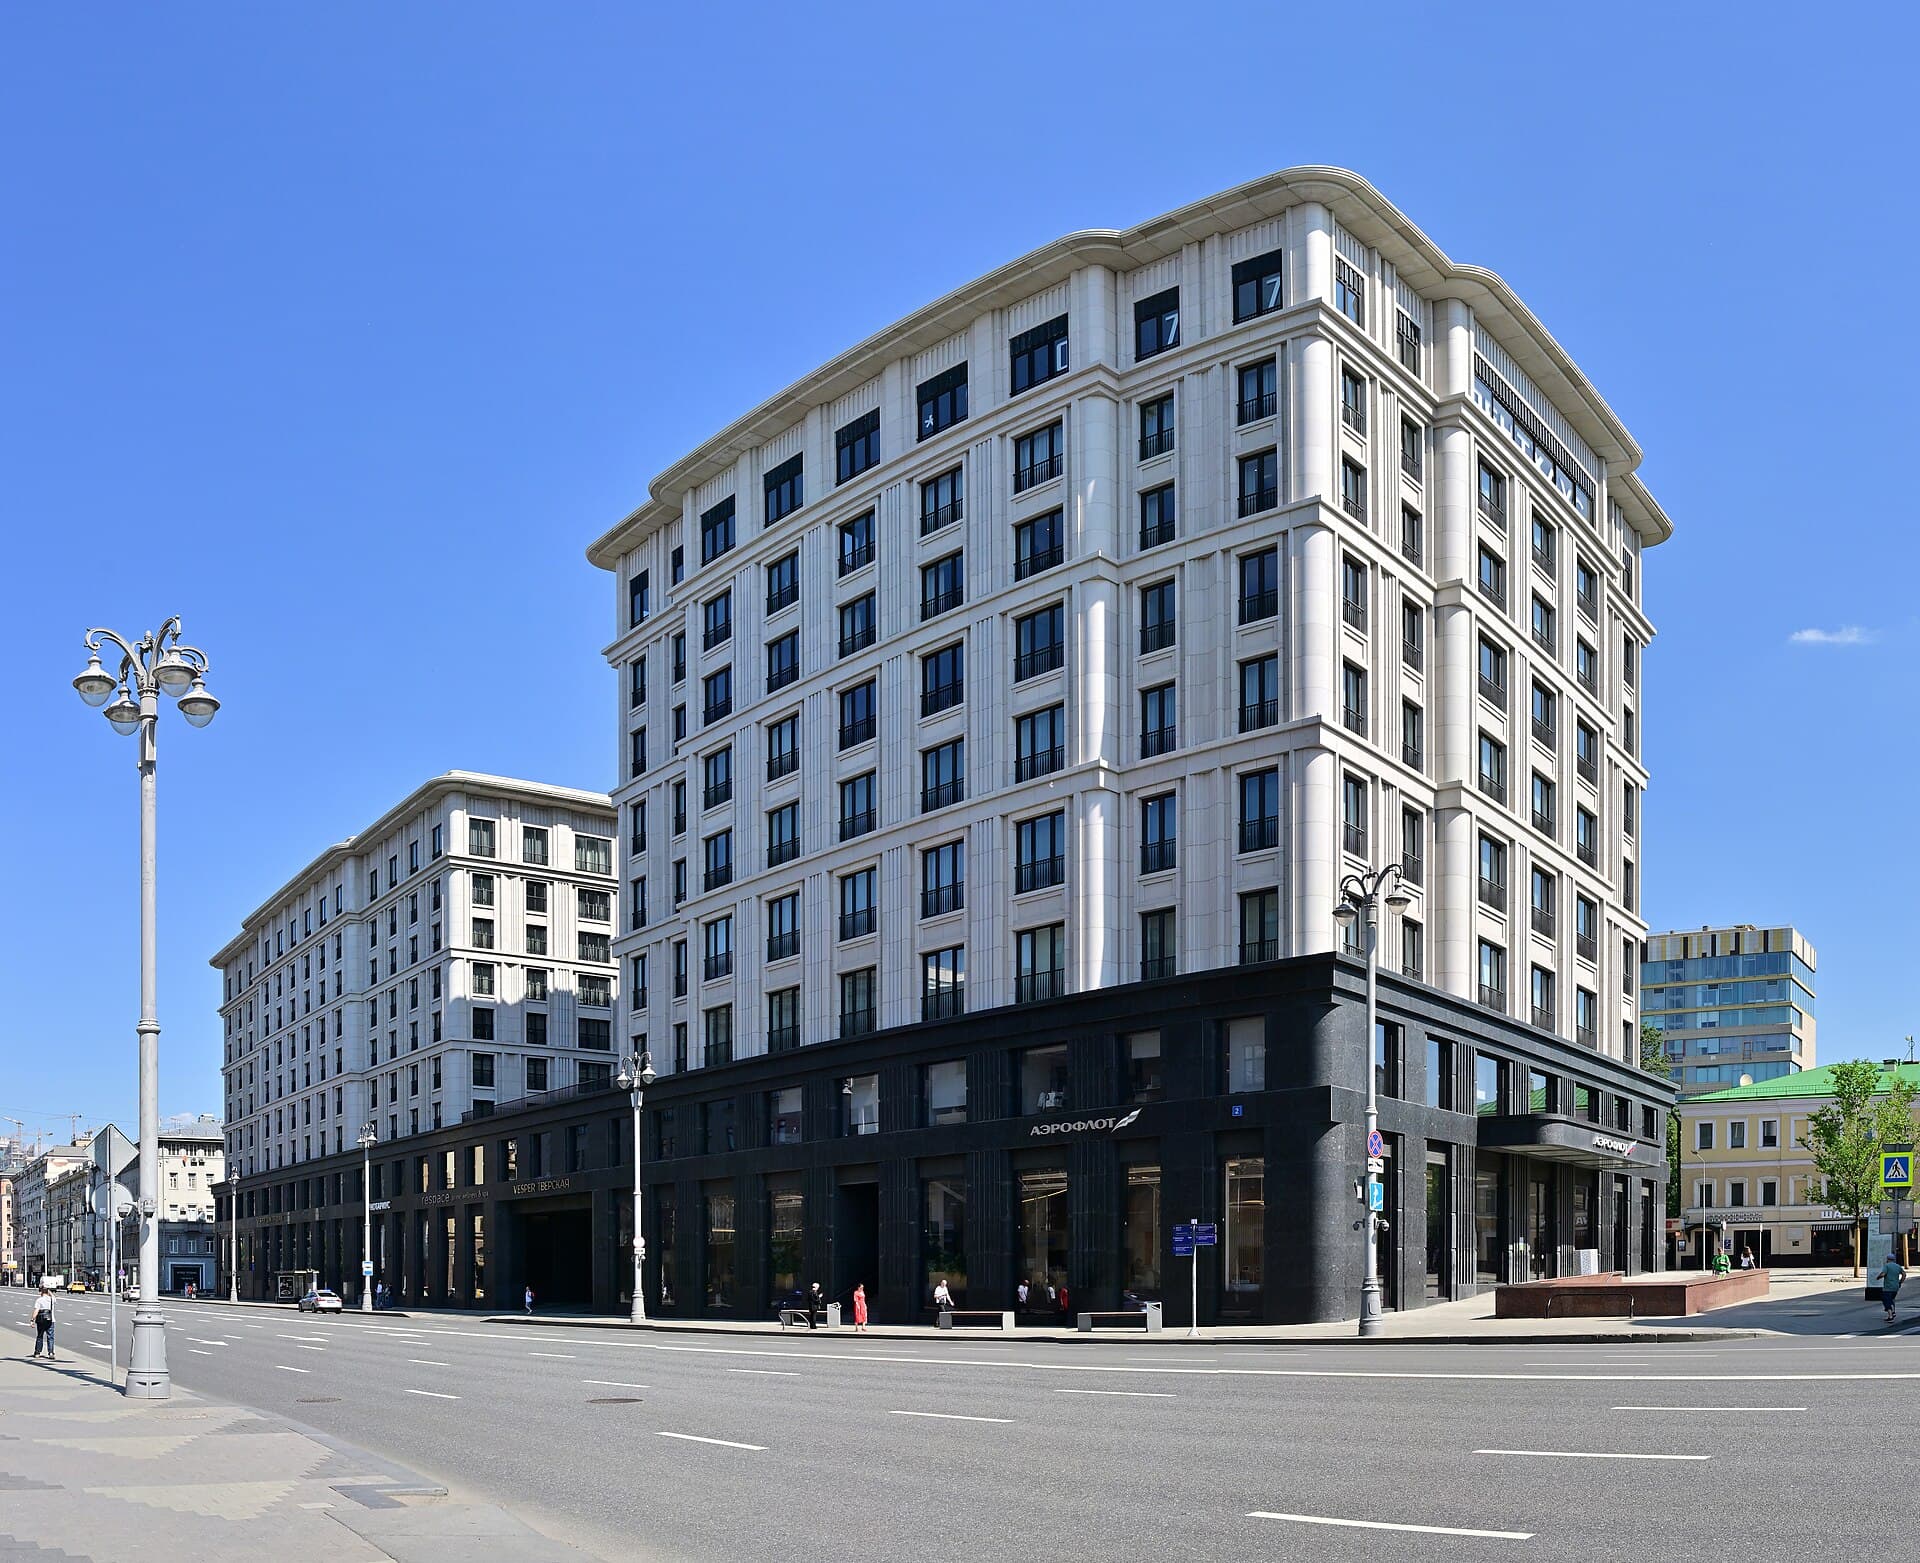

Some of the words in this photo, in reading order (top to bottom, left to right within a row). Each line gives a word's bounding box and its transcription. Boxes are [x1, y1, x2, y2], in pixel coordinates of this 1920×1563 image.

[1165, 312, 1179, 345] 7
[1266, 275, 1281, 308] 7
[1030, 1117, 1117, 1136] АЭРОФЛОТ
[513, 1182, 536, 1194] VESPER
[537, 1177, 570, 1192] ТВЕРСКАЯ
[421, 1193, 450, 1206] respace
